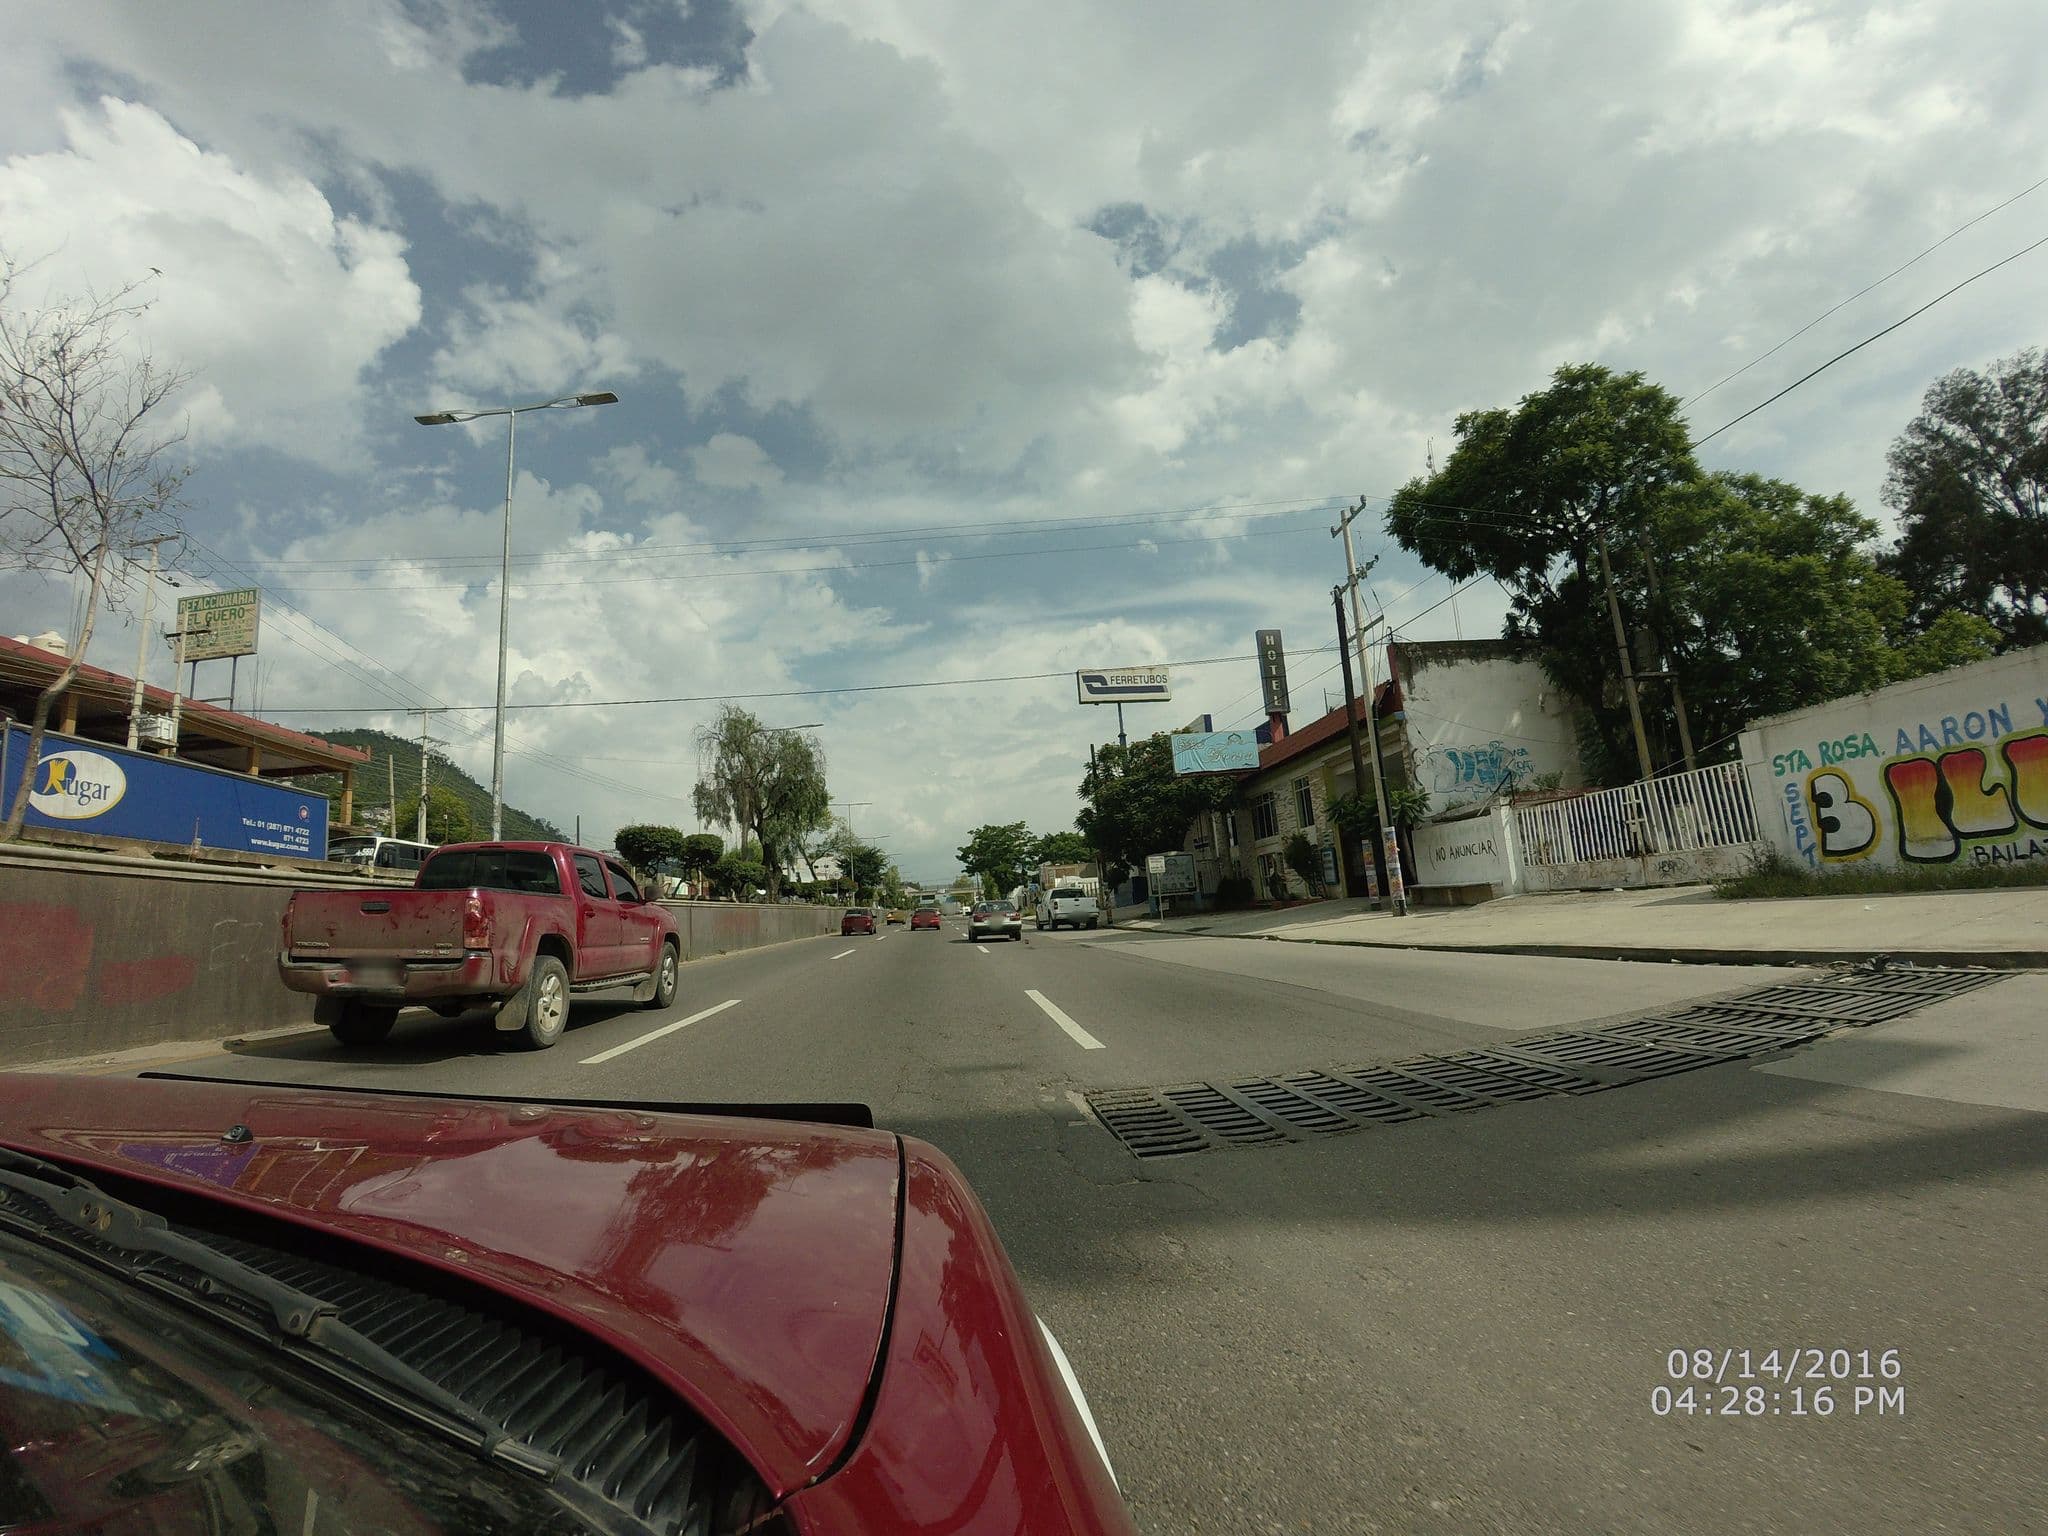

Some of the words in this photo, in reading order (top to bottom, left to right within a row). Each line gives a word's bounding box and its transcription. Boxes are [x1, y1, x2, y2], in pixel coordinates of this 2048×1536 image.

[180, 590, 254, 613] REFACCIONARIA
[188, 613, 201, 626] EL
[1110, 674, 1168, 685] FERRETUBOS
[1265, 635, 1282, 706] HOTEL
[1896, 703, 2013, 756] AARON
[1773, 750, 1812, 777] STA
[1784, 782, 1817, 870] SEPT
[1973, 840, 2048, 868] BAILA
